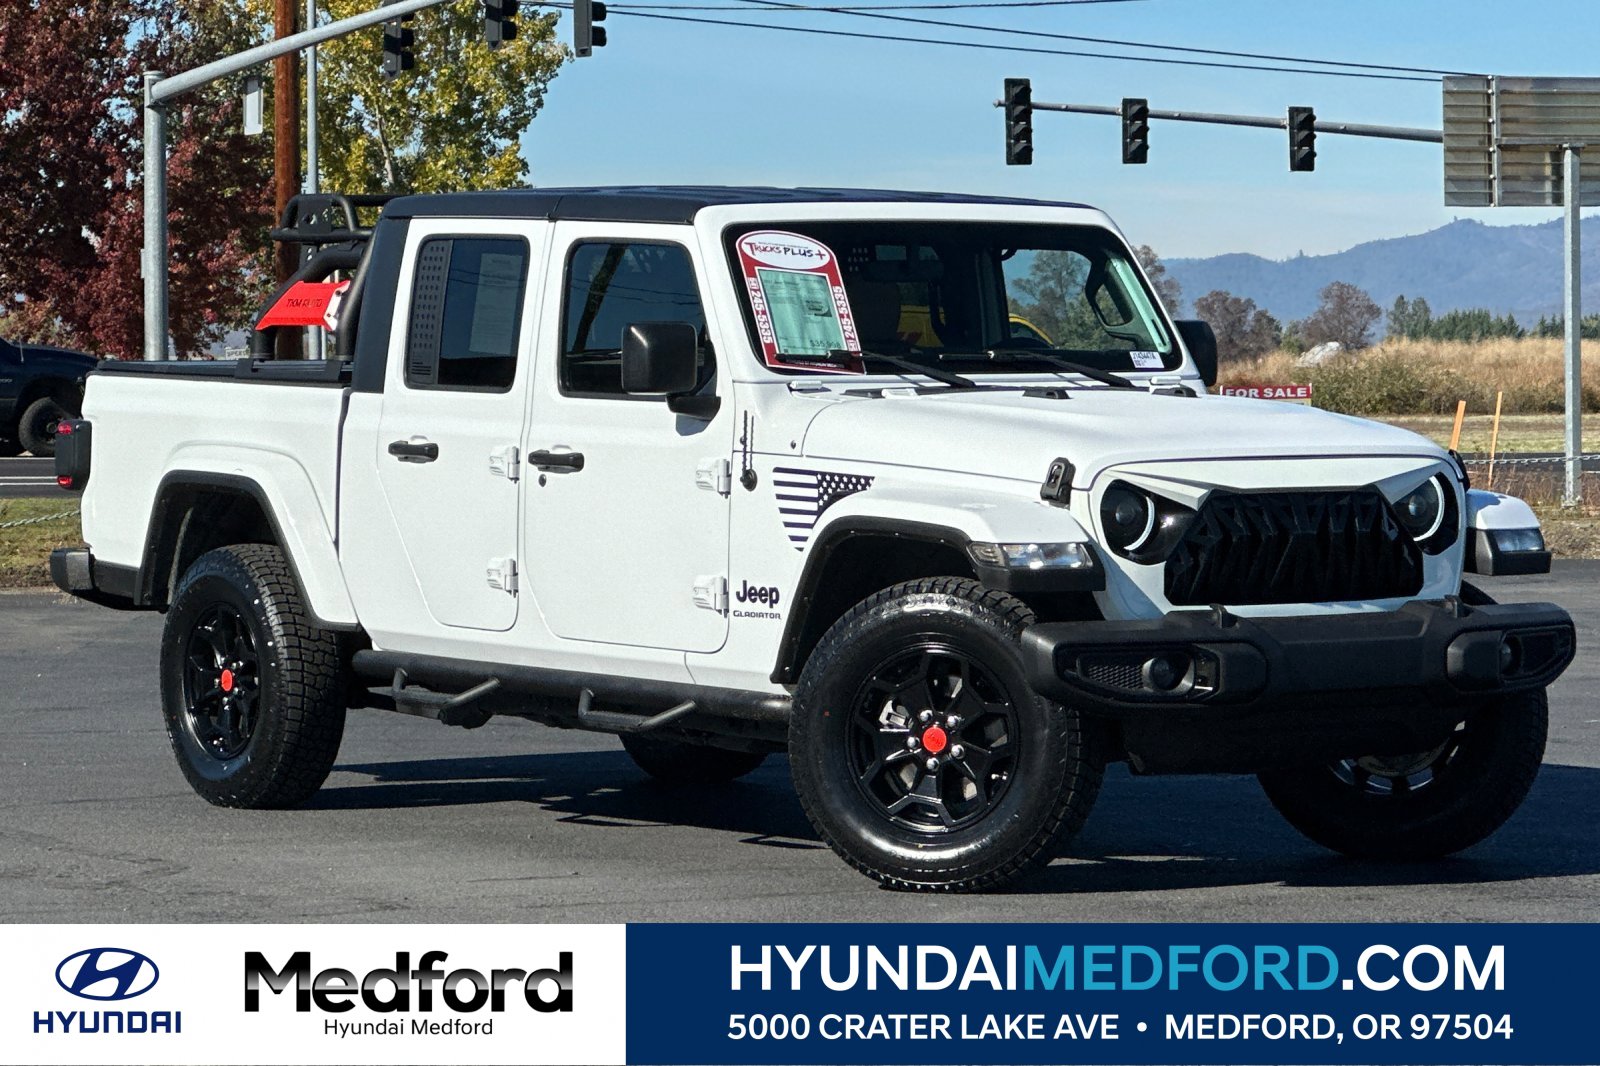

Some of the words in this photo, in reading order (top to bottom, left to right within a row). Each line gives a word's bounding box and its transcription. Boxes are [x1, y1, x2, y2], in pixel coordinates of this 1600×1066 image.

[751, 290, 774, 344] 245-5335
[832, 285, 855, 340] 245-5335
[1225, 388, 1260, 399] FOR
[1263, 387, 1308, 398] SALE
[735, 580, 780, 609] Jeep
[733, 610, 782, 620] GLADIATOR
